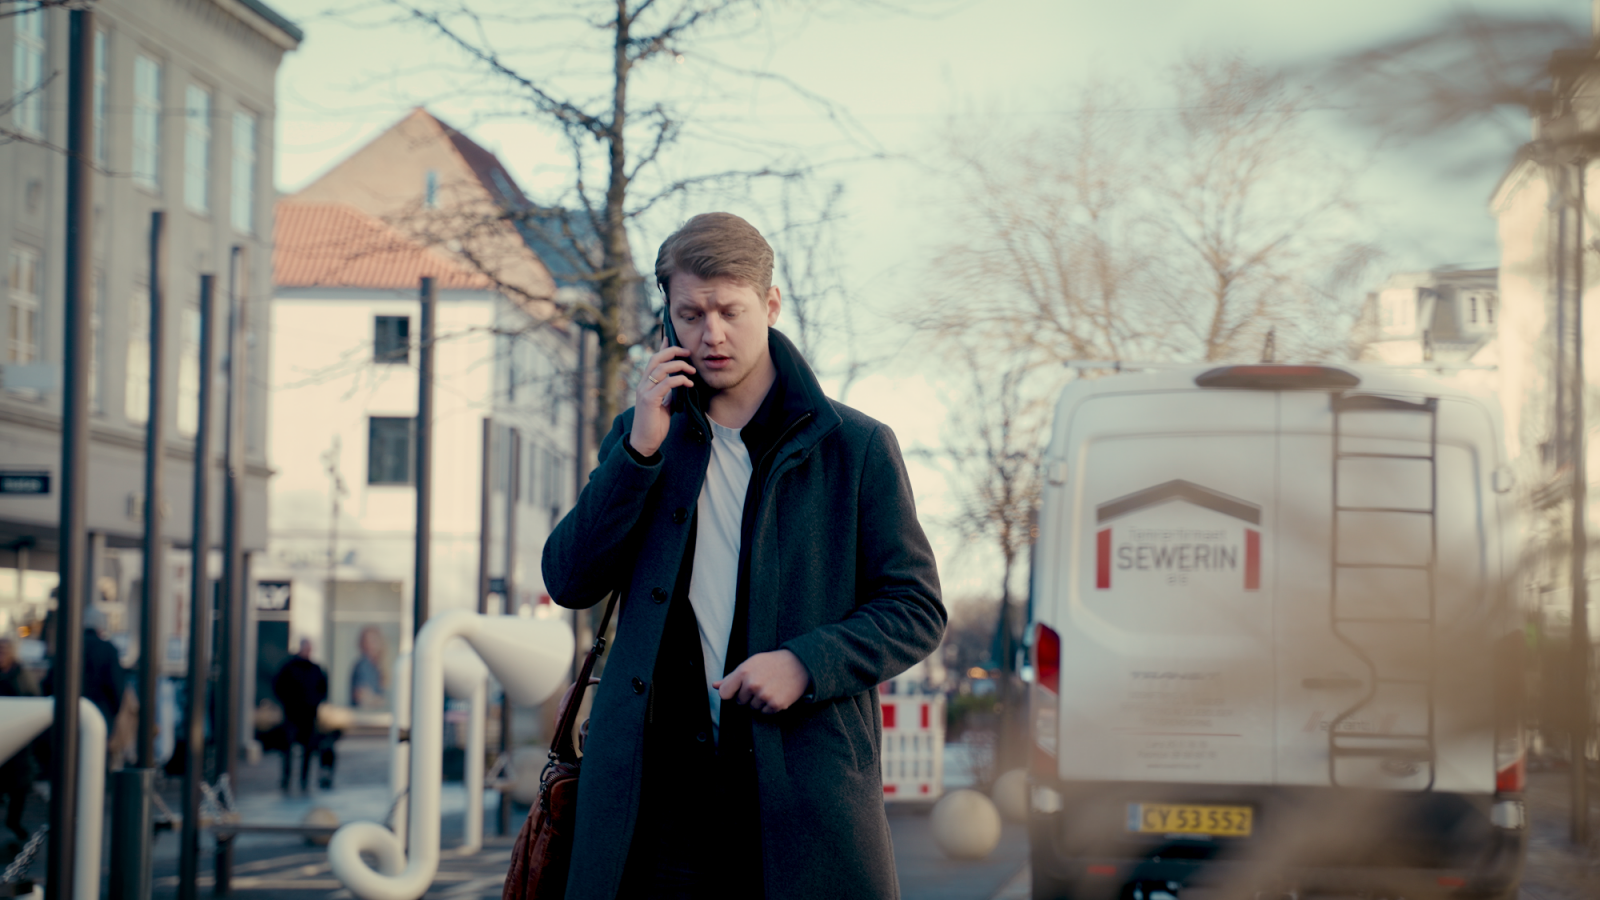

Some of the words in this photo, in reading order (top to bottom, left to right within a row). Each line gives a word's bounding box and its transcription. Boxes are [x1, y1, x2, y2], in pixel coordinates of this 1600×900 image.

[1117, 544, 1238, 571] SEWERIN
[1143, 808, 1171, 830] CY
[1176, 808, 1202, 830] 53
[1208, 809, 1246, 832] 552
